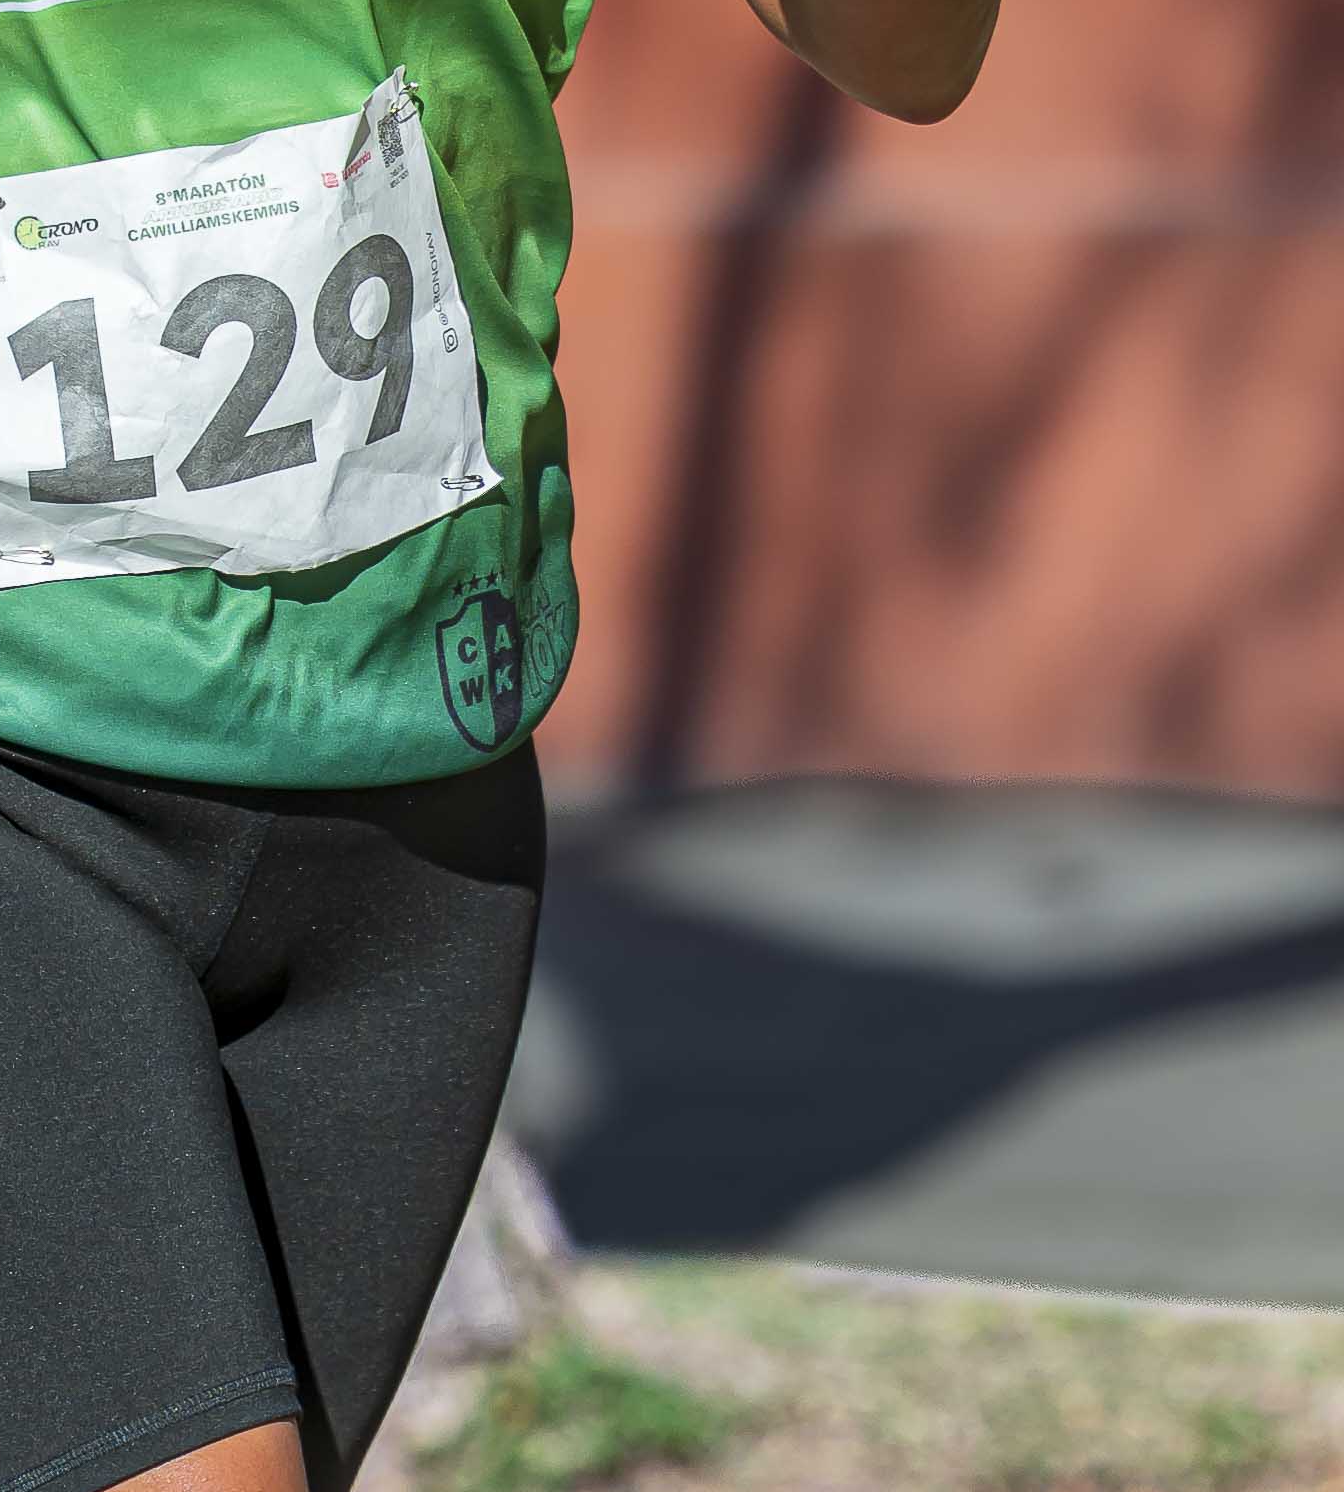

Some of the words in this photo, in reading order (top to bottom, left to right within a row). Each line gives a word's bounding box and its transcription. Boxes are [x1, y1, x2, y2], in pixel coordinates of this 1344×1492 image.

[155, 173, 266, 206] 8°MARATÓN
[127, 200, 301, 242] CAWILLIAMSKEMMIS
[38, 239, 60, 249] RAV
[6, 233, 415, 505] 129
